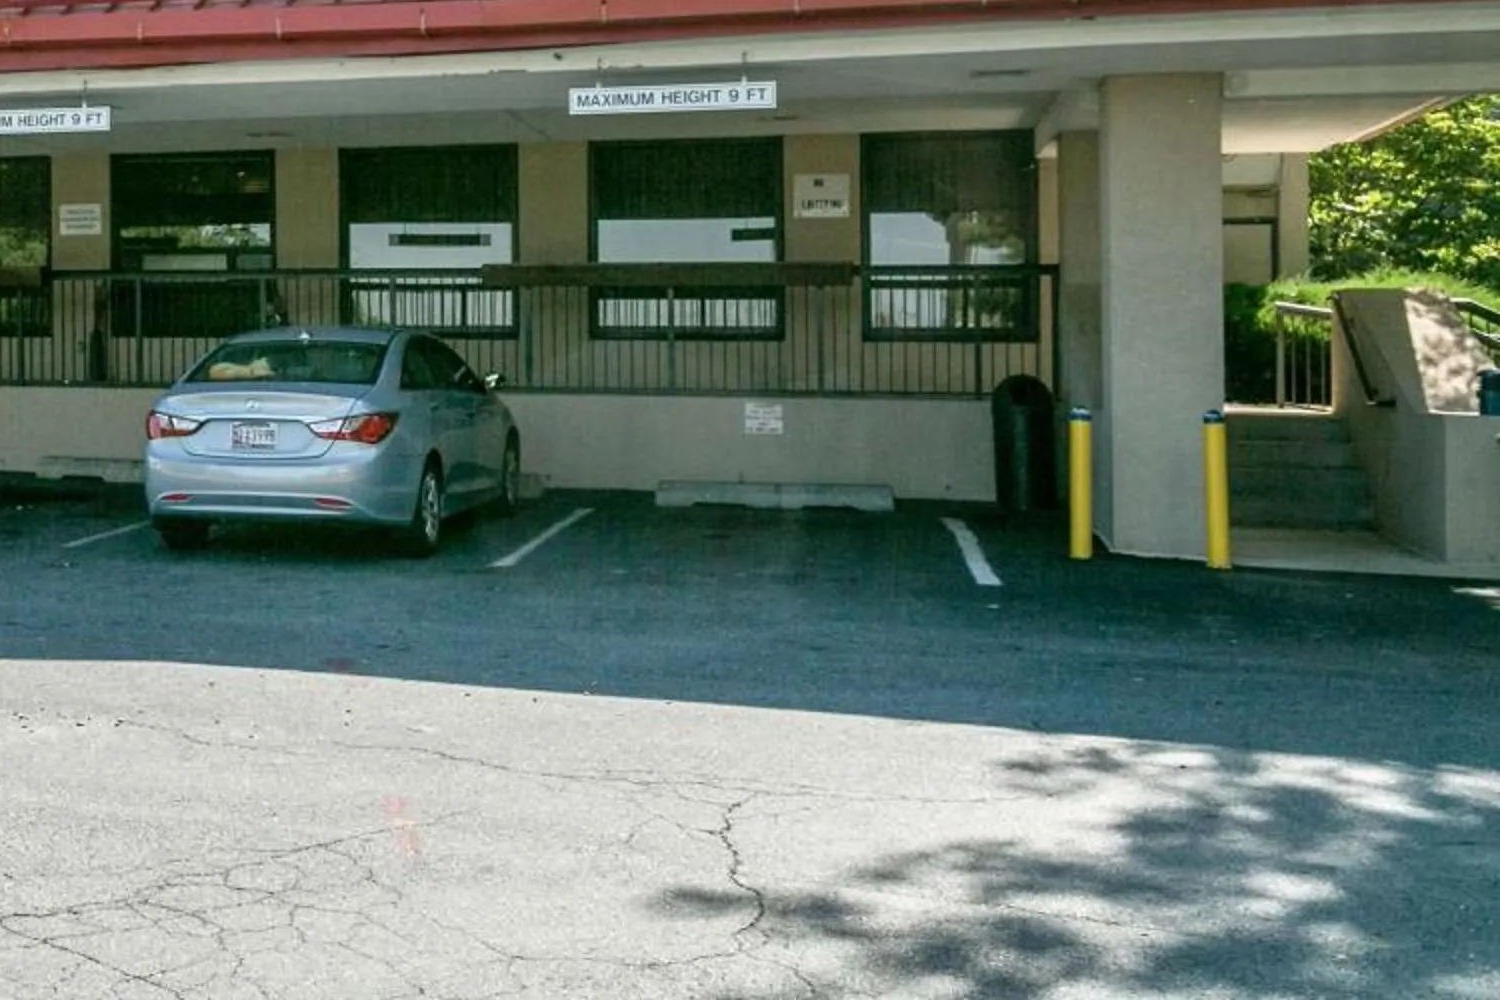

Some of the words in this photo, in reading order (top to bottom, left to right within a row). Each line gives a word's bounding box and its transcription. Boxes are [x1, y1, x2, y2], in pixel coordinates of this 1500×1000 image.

[576, 92, 654, 107] MAXIMUM
[661, 89, 720, 104] HEIGHT
[728, 90, 739, 103] 9
[747, 87, 767, 101] FT
[17, 113, 67, 127] HEIGHT
[71, 113, 80, 125] 9
[86, 112, 103, 125] FT
